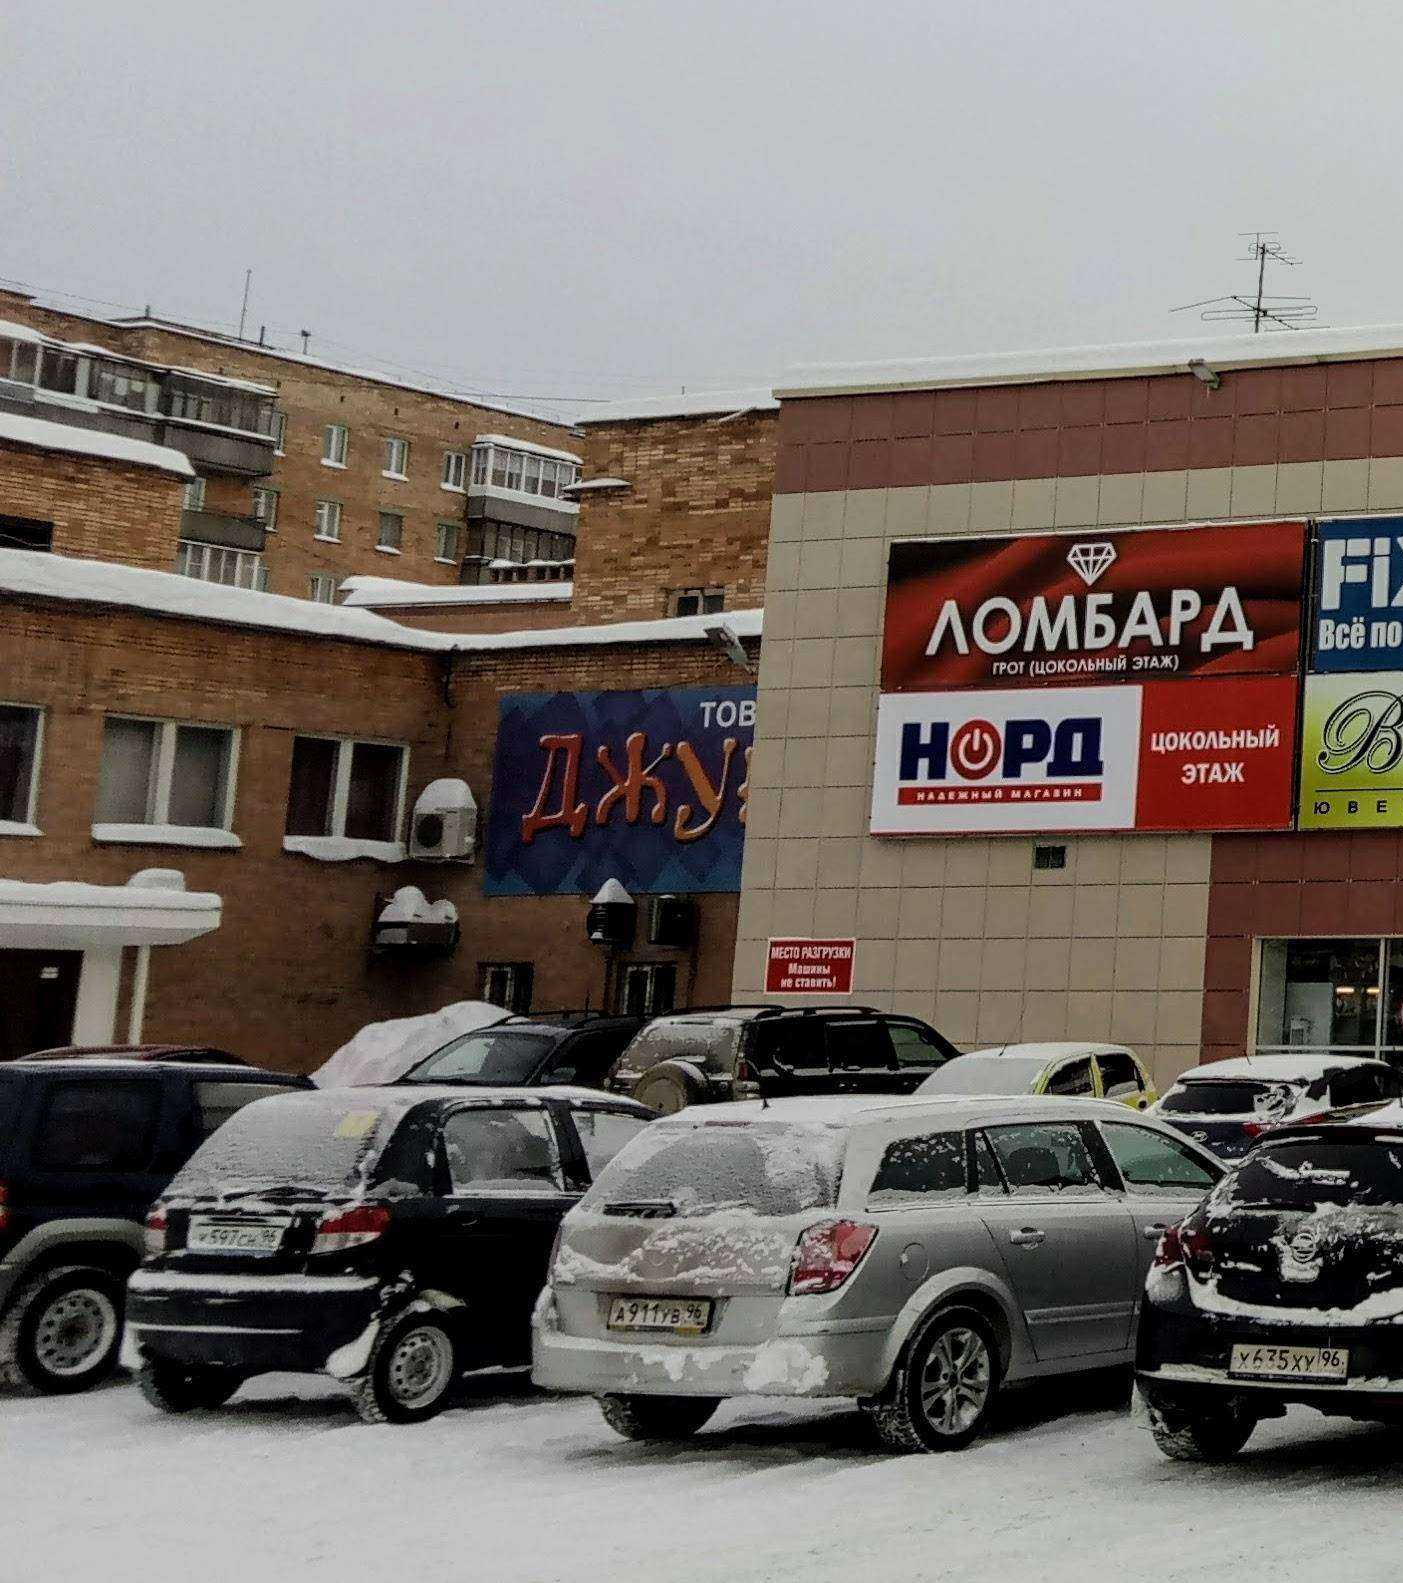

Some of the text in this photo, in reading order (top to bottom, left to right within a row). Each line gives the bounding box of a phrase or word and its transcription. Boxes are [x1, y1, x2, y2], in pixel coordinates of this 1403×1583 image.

[925, 586, 1255, 656] ЛОМБАРД
[1319, 618, 1365, 651] Всё
[1370, 621, 1401, 648] по
[992, 654, 1180, 677] ГРОТ (ЦОКОЛЬНЫЙ ЭТАЖ)
[900, 717, 1104, 781] НОРД
[1151, 724, 1280, 754] ЦОКОЛЬНЫЙ
[1180, 762, 1245, 785] ЭТАЖ
[521, 731, 754, 844] ДЖУ
[771, 946, 852, 959] МЕСТО РАЗГРУЗКИ
[788, 962, 831, 975] Машины
[1321, 1350, 1340, 1367] 96
